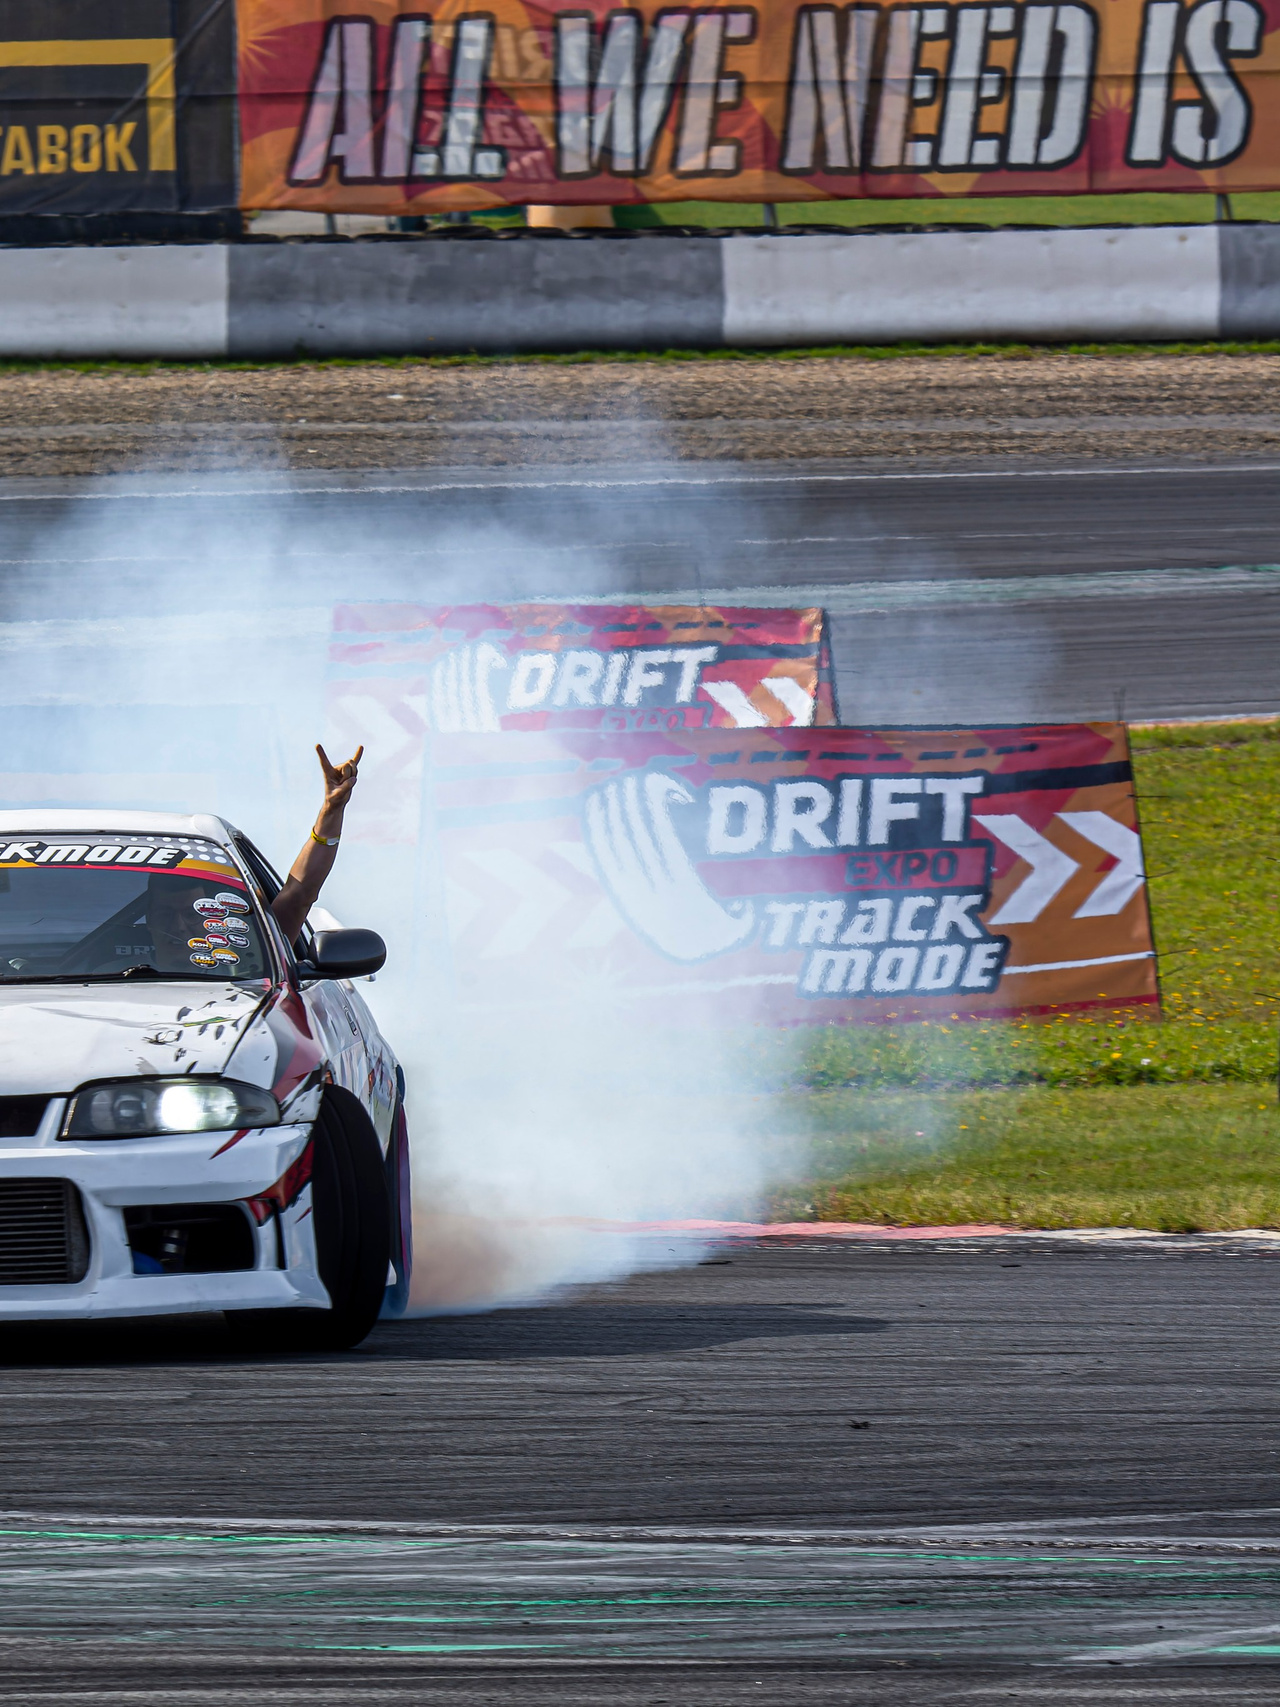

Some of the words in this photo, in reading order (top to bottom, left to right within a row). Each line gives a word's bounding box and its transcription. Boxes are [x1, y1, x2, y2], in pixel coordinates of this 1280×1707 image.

[287, 12, 508, 187] ALL
[554, 6, 757, 180] WE
[779, 2, 1100, 175] NEED
[1124, 0, 1267, 169] IS
[506, 645, 719, 710] DRIFT
[706, 775, 985, 855] DRIFT
[34, 844, 180, 866] MODE
[844, 849, 959, 887] EXPO
[766, 893, 985, 947] TRACK
[799, 942, 1005, 994] MODE
